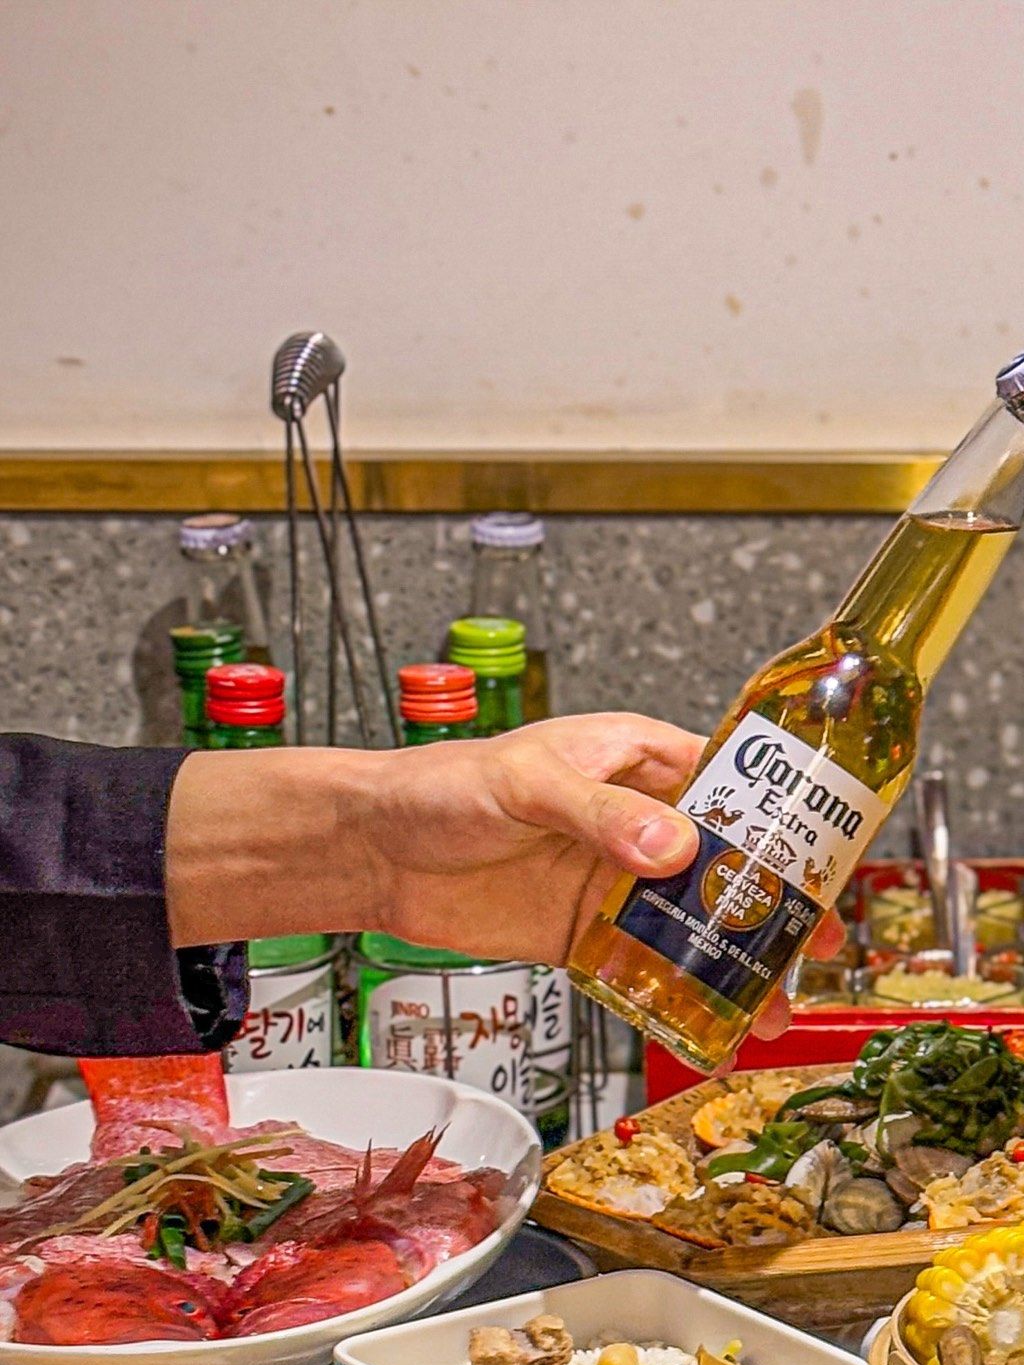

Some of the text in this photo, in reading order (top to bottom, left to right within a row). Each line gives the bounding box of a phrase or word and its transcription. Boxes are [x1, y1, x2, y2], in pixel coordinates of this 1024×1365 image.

[734, 734, 864, 841] Corona
[755, 788, 818, 846] Extra
[716, 864, 772, 907] CERVEZA
[724, 885, 753, 909] MAS
[715, 895, 746, 920] FINA
[687, 932, 723, 960] MEXICO
[390, 1001, 430, 1020] JINRO
